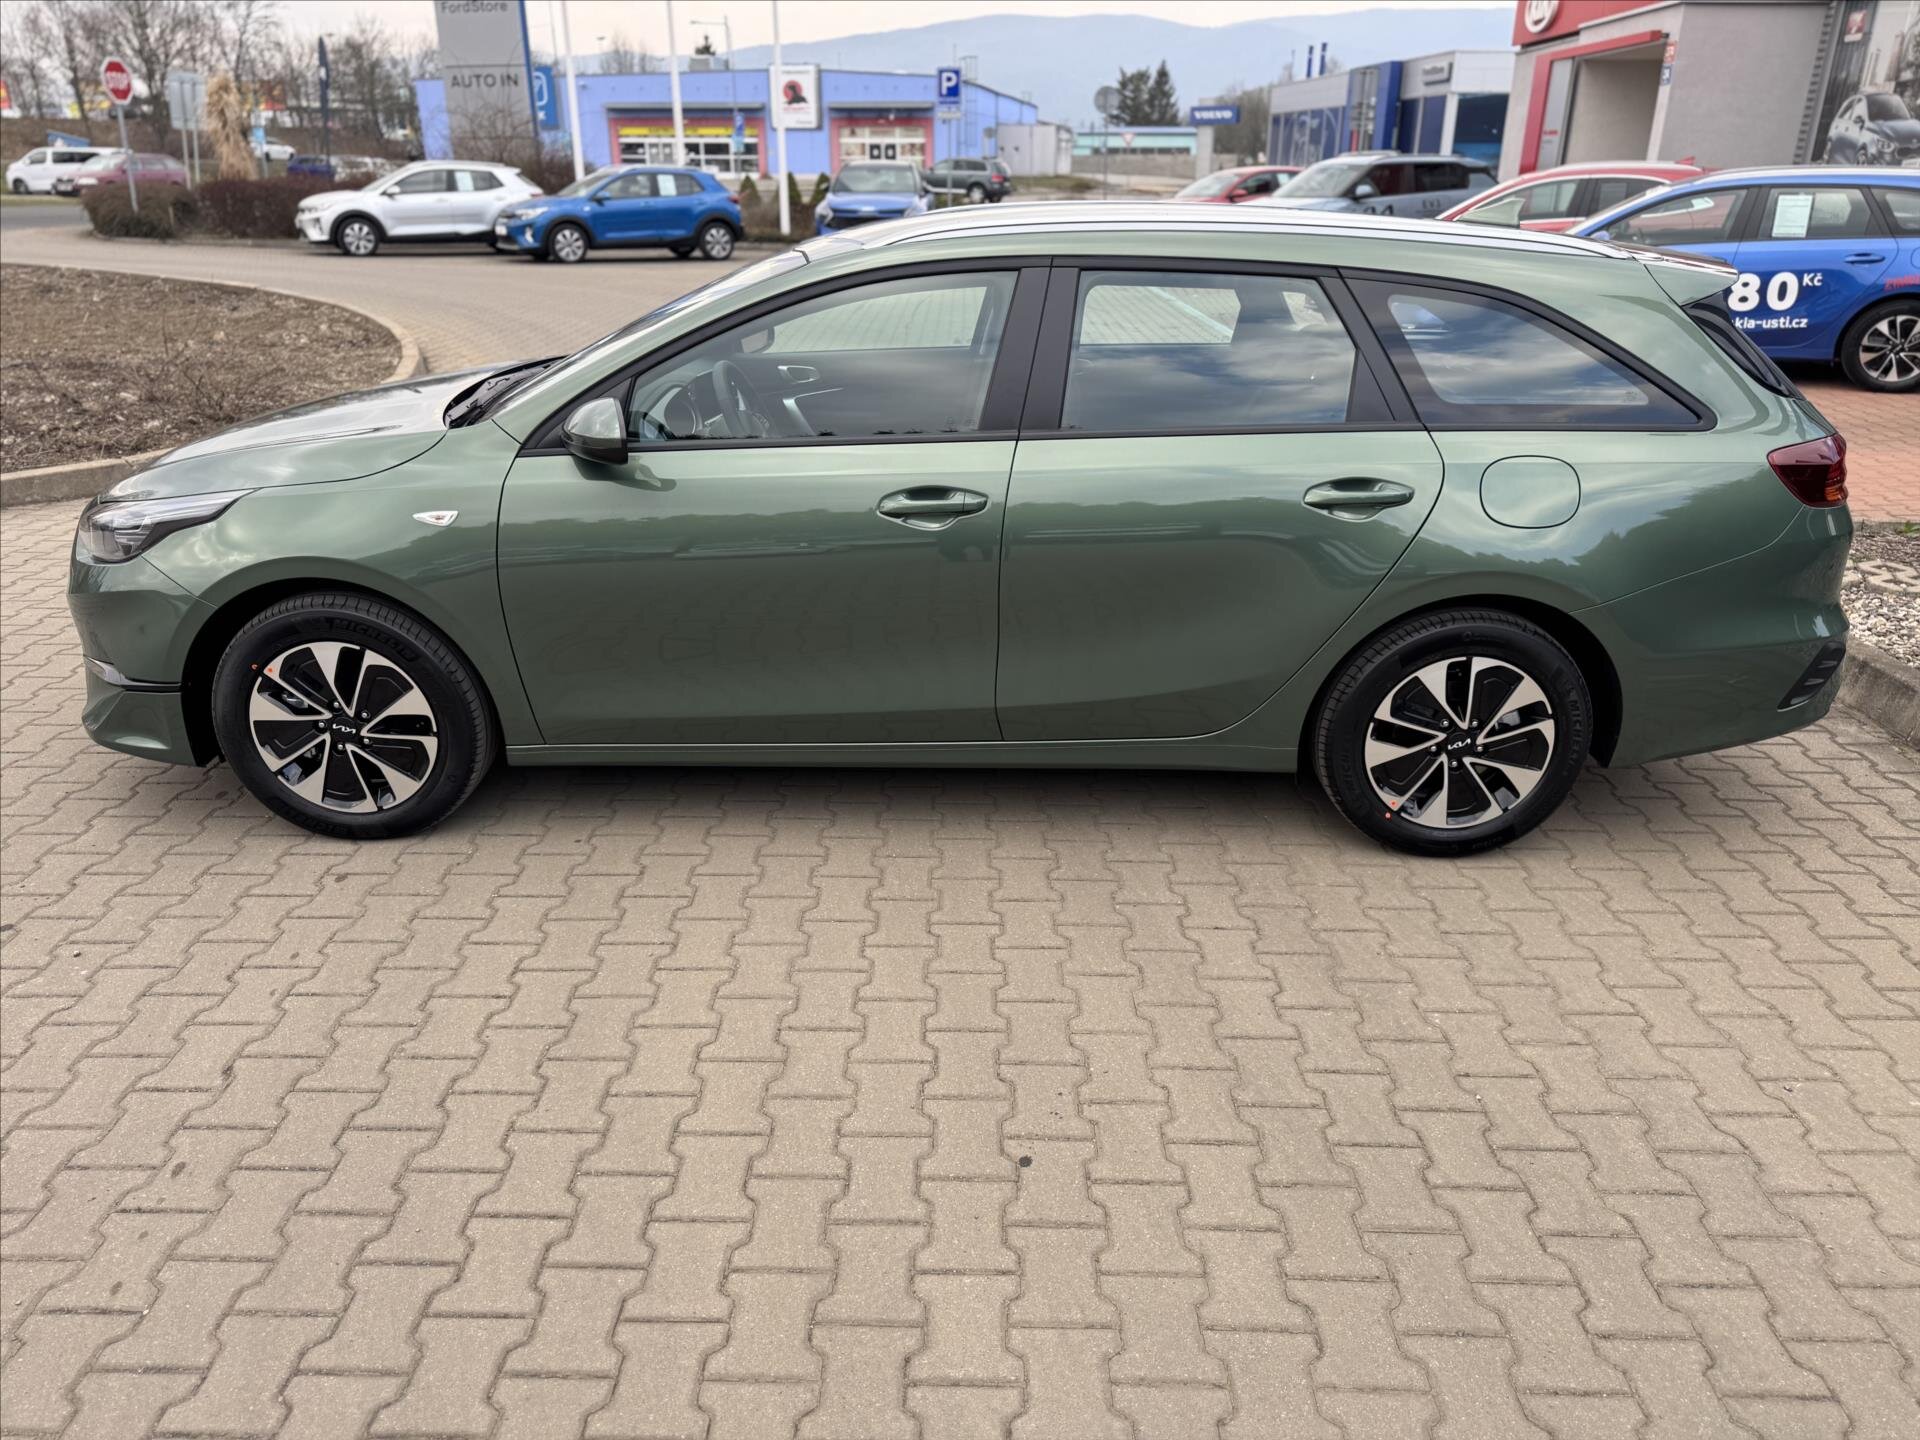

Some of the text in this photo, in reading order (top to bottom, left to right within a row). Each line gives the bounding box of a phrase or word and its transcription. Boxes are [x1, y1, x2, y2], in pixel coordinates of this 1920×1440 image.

[441, 0, 508, 13] FordStore
[106, 71, 130, 89] STOP
[451, 73, 518, 88] AUTO IN
[941, 71, 957, 95] P
[1193, 110, 1233, 120] VOLVO
[1802, 273, 1823, 287] Kč
